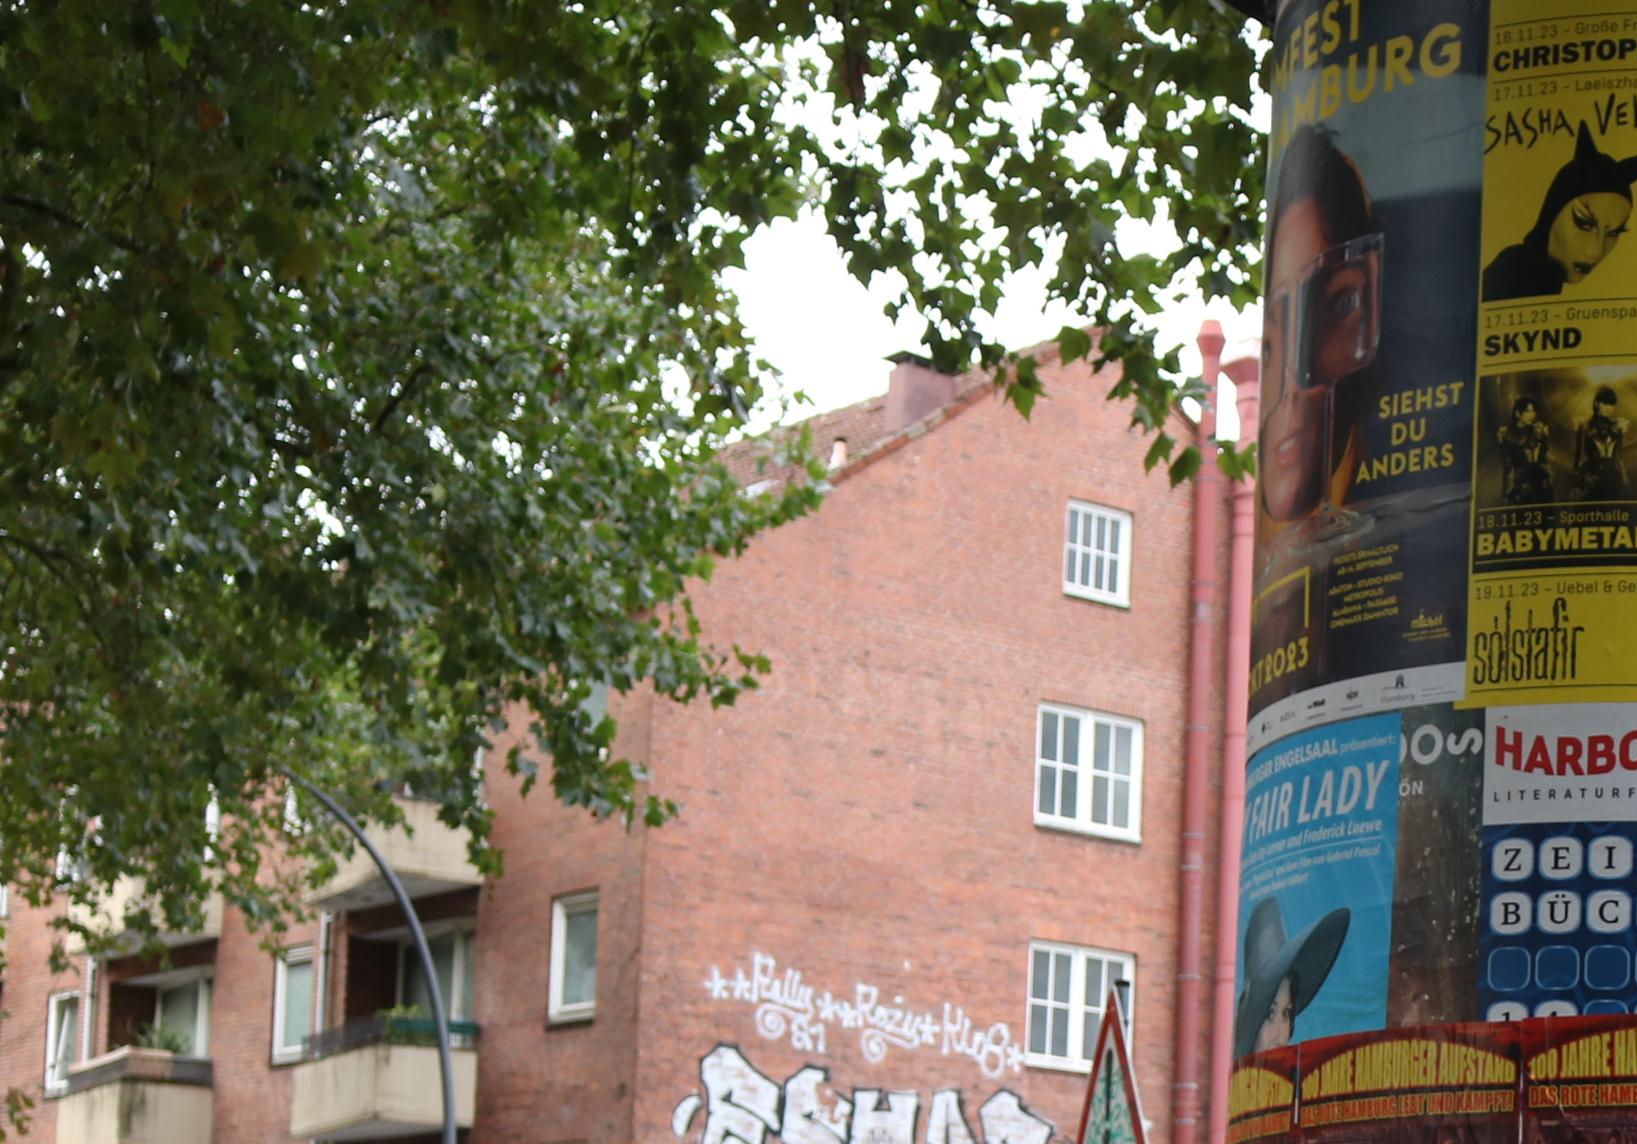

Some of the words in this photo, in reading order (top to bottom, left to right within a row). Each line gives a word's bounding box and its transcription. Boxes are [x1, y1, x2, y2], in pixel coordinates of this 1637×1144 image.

[1575, 20, 1618, 35] Große
[1484, 107, 1575, 155] SASHA
[1485, 310, 1549, 329] 17.11.23
[1484, 326, 1582, 356] SKYND
[1378, 381, 1465, 419] SIEHST
[1391, 417, 1427, 446] DU
[1355, 443, 1455, 485] ANDERS
[1478, 511, 1542, 529] 18.11.23
[1559, 509, 1630, 525] Sporthalle
[1475, 582, 1540, 600] 19.11.23
[1557, 579, 1598, 595] Uebel
[1274, 738, 1338, 773] ENGELSAAL
[1251, 781, 1294, 839] FAIR
[1297, 759, 1391, 824] LADY
[1529, 1048, 1558, 1080] 100
[1560, 1030, 1611, 1078] JAHRE
[1529, 1083, 1559, 1108] DAS
[1559, 1083, 1600, 1107] ROTE
